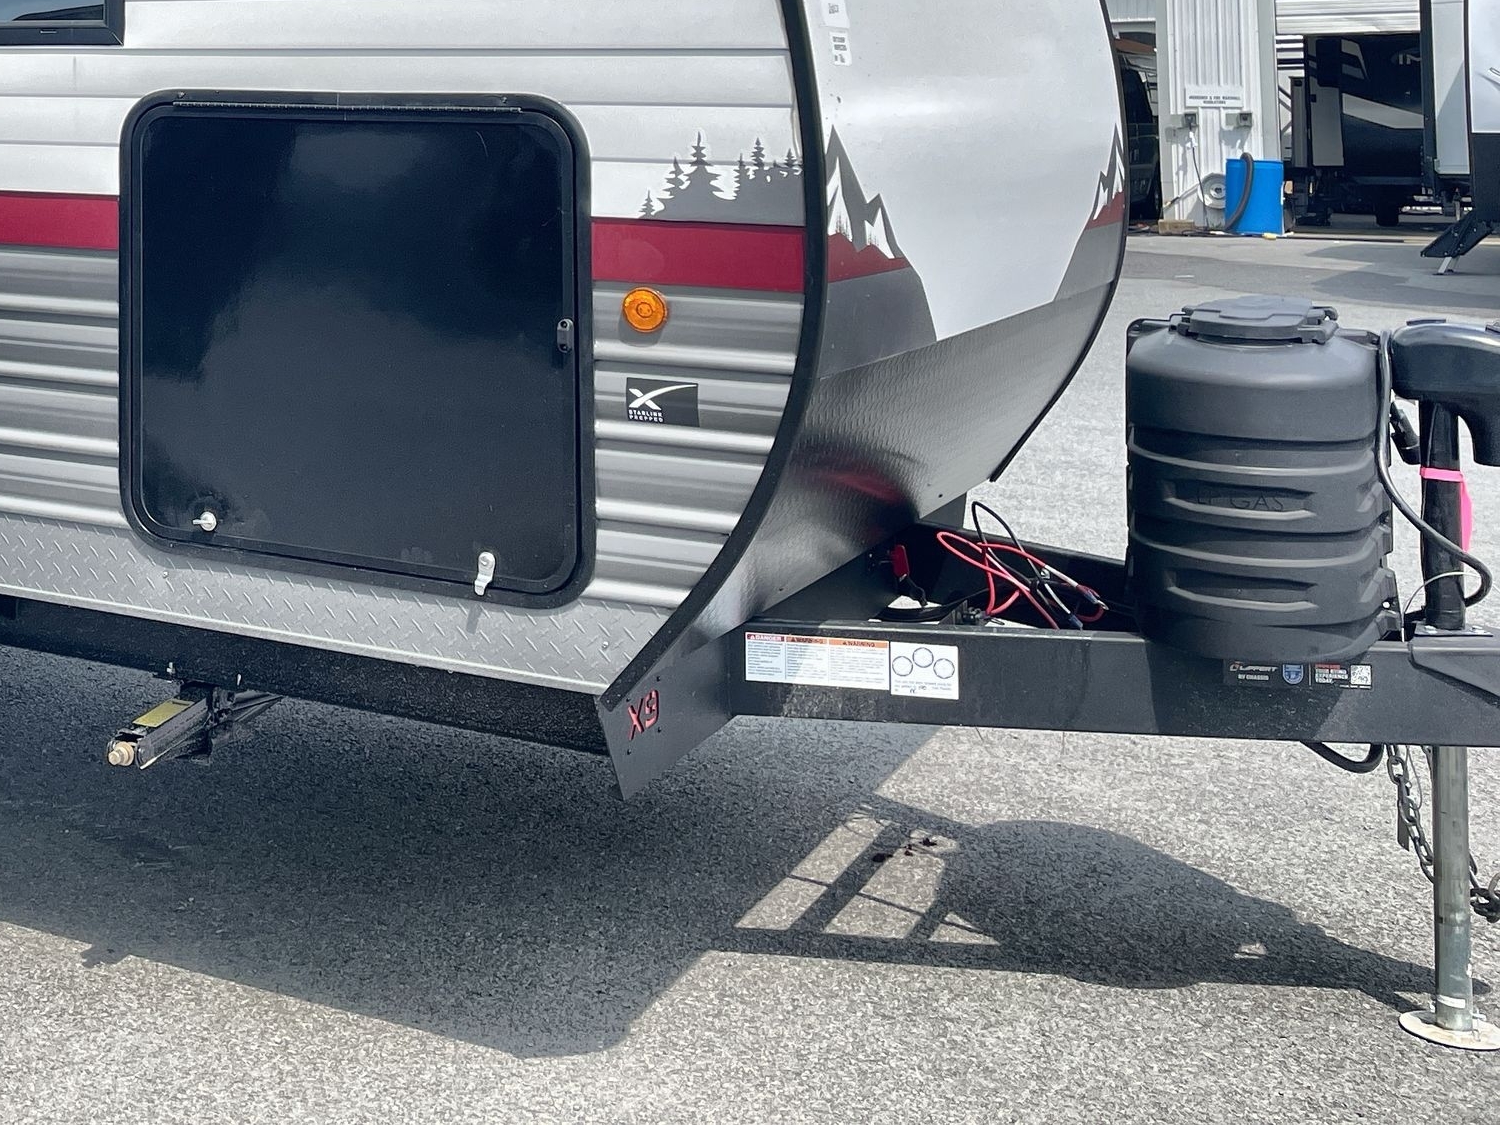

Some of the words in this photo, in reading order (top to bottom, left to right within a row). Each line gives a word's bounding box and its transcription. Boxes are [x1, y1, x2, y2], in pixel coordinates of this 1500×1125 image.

[628, 409, 663, 418] STARLINK
[628, 414, 664, 423] PREPPED
[1230, 491, 1284, 512] GAS
[627, 689, 660, 741] X9
